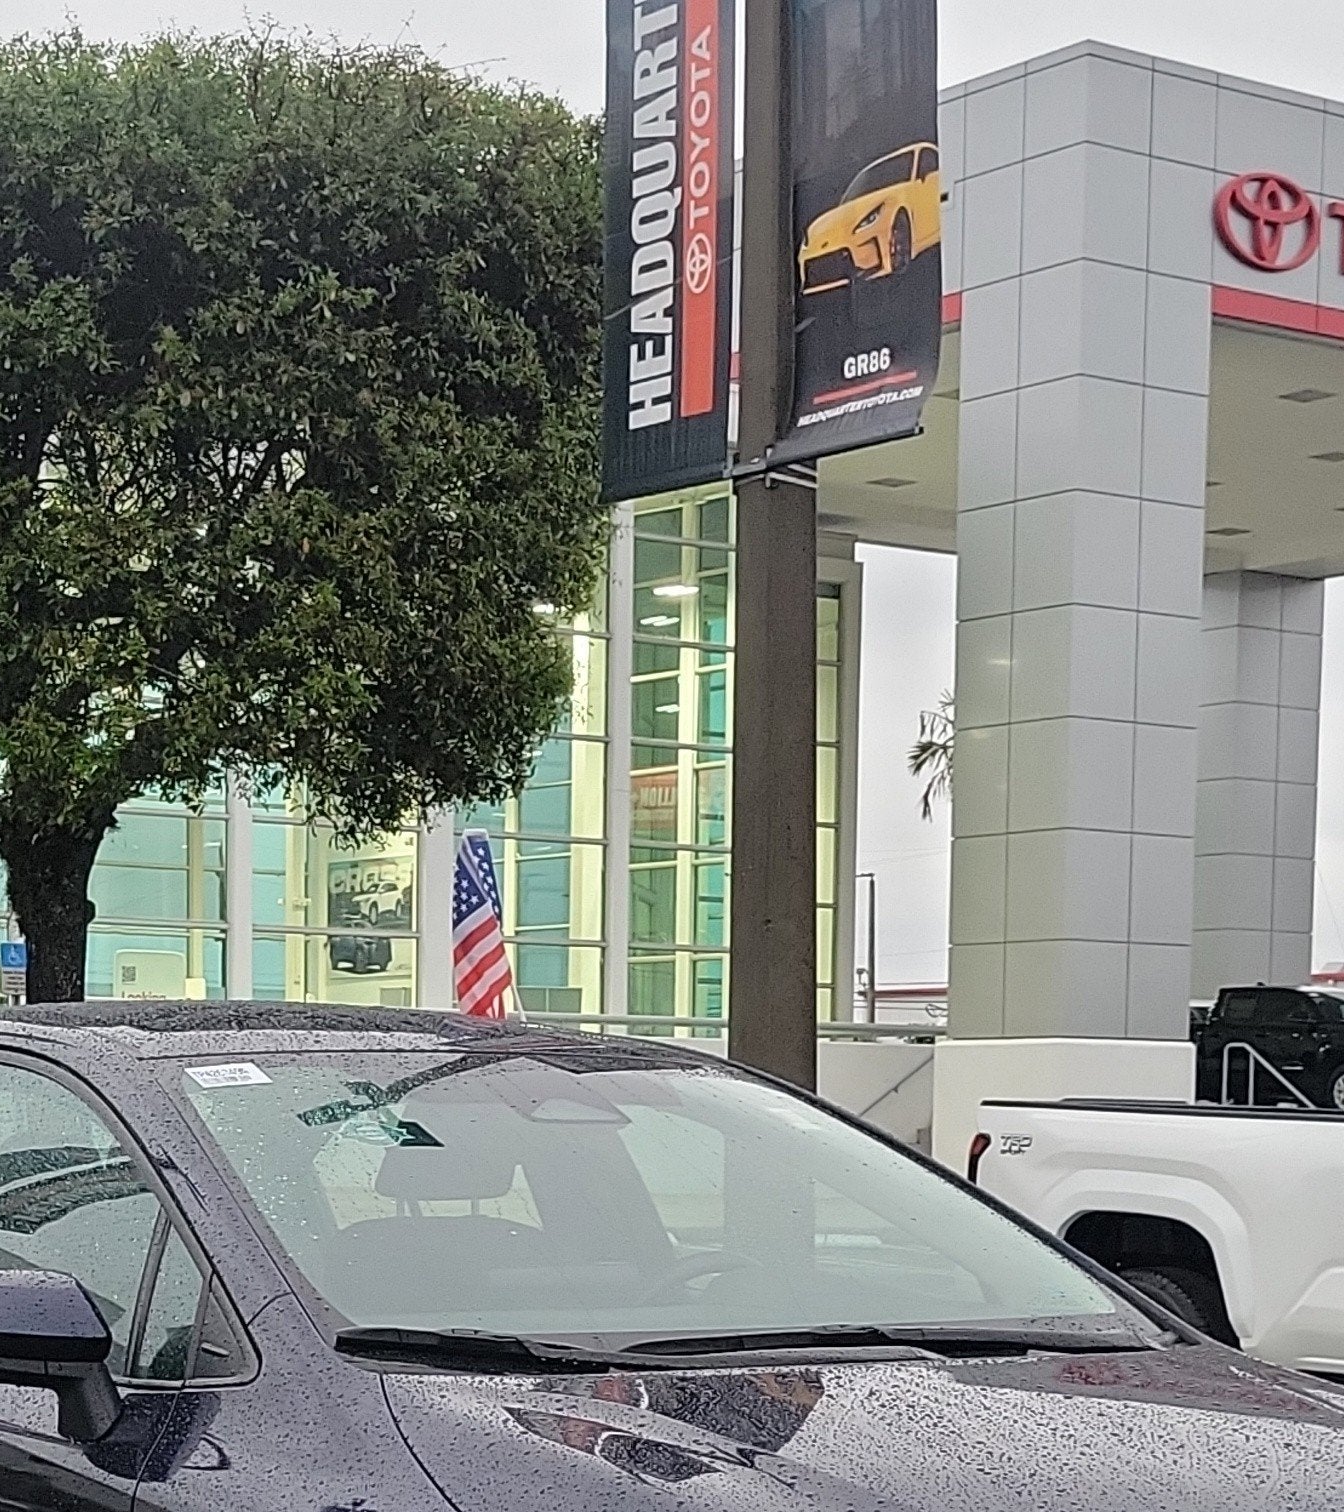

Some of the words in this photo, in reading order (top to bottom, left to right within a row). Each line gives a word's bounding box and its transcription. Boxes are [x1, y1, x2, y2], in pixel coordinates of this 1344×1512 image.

[628, 0, 682, 430] HEADQUART
[689, 25, 712, 230] TOYOTA
[843, 347, 891, 379] GR86
